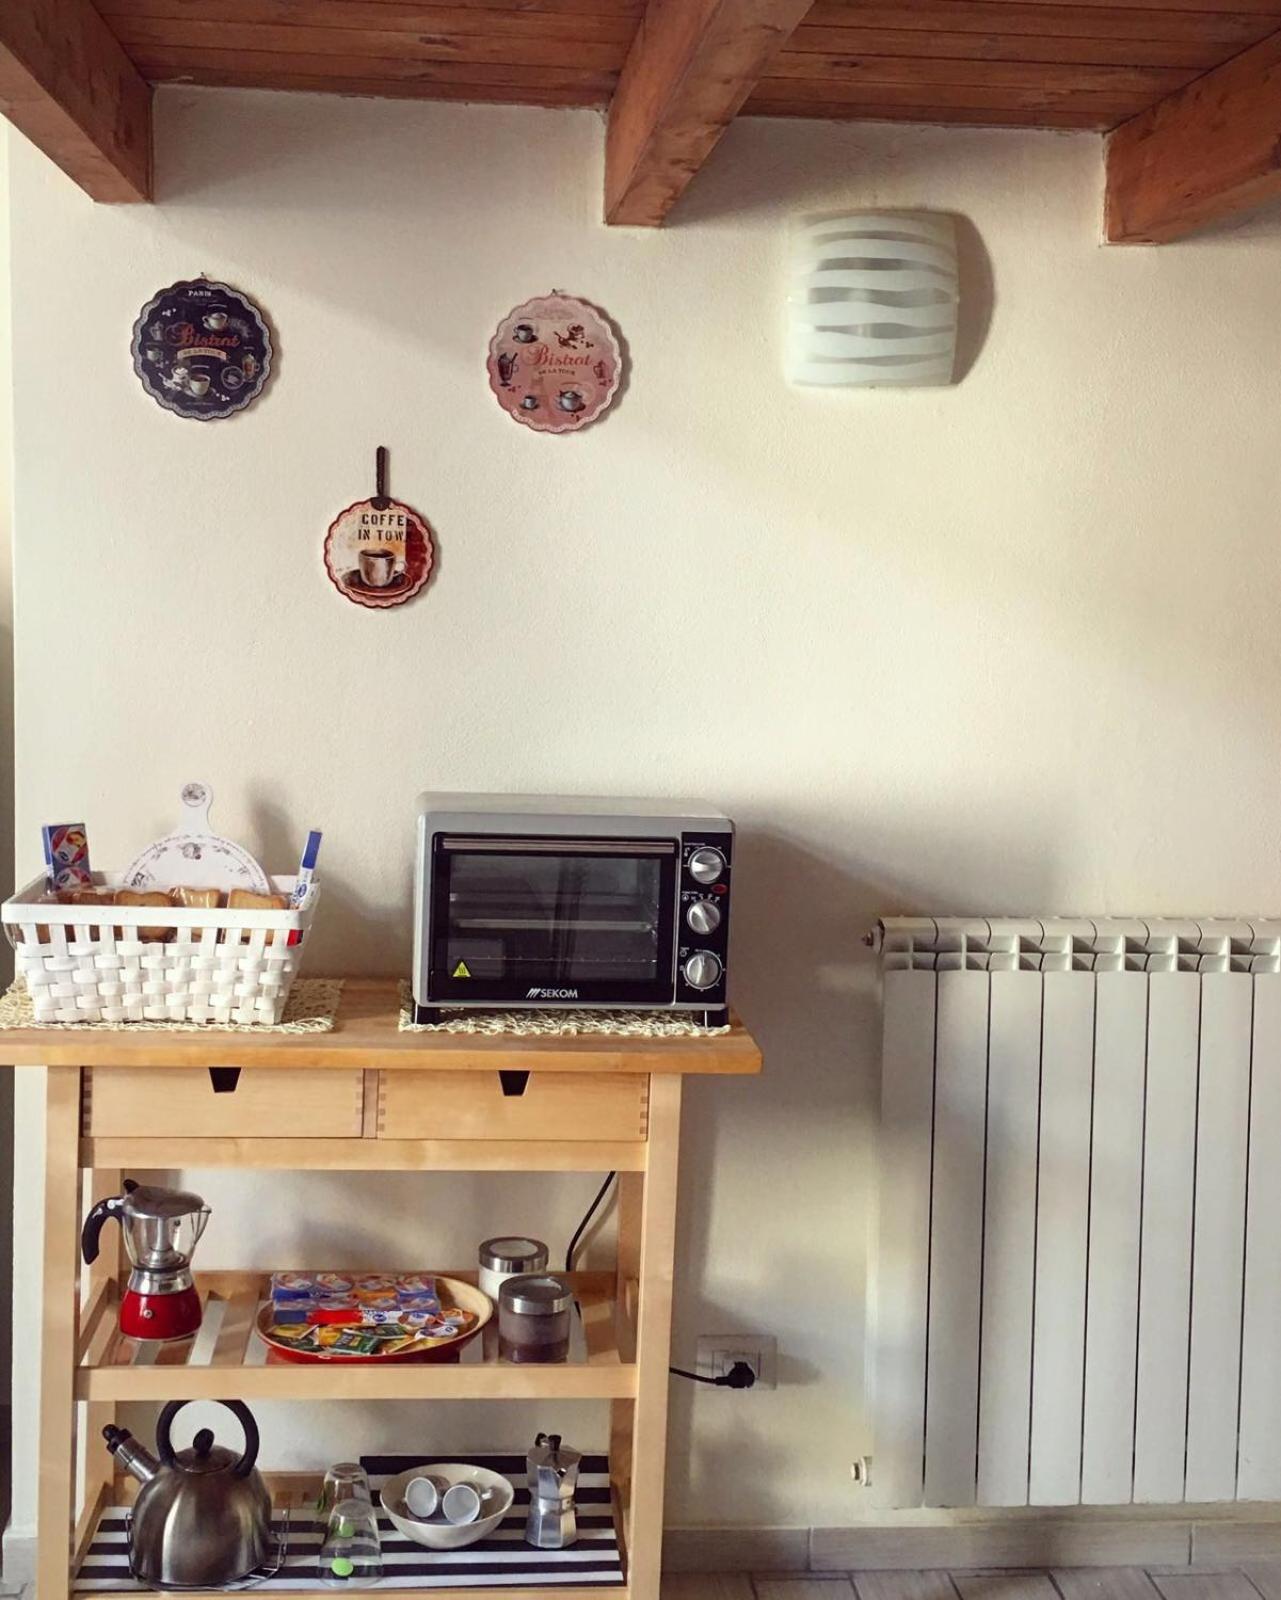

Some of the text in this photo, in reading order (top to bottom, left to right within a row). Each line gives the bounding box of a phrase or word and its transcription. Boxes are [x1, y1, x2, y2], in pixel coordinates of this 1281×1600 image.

[187, 289, 213, 297] PARIS
[357, 528, 370, 541] IN
[540, 988, 578, 999] SEKOM
